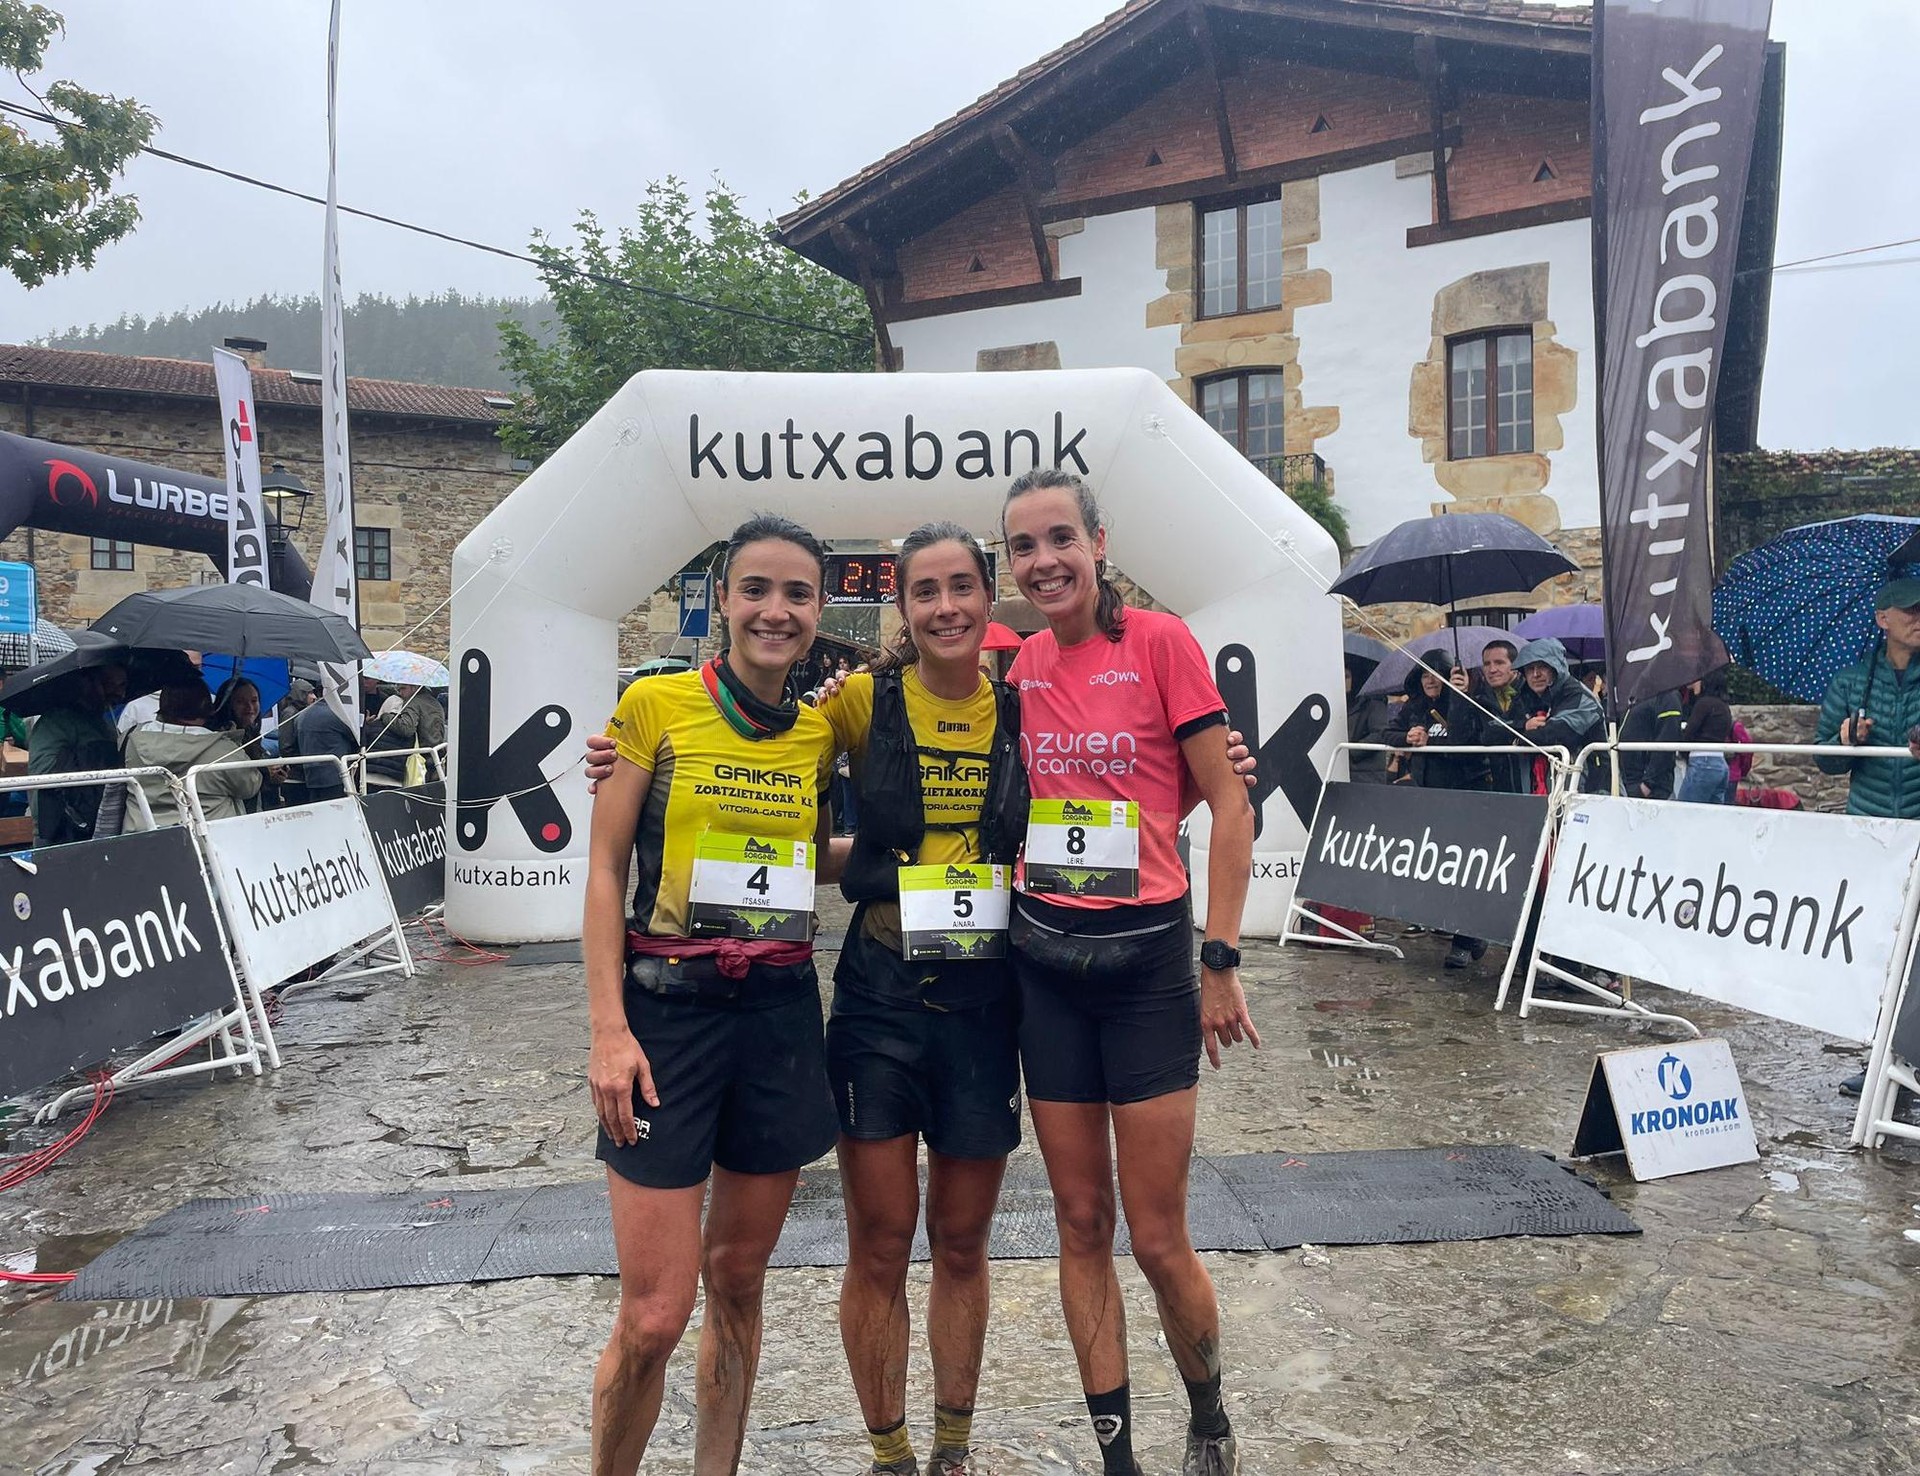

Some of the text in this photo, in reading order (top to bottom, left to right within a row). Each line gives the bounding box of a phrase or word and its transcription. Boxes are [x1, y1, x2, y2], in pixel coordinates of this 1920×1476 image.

[689, 411, 1089, 482] kutxabank
[1088, 670, 1141, 686] CROWN
[1036, 731, 1136, 754] zuren
[714, 763, 802, 789] GAIKAR
[1036, 758, 1137, 779] camper
[694, 784, 795, 804] ZORTZIETAKOAK
[718, 803, 801, 819] VITORIA-GASTEIZ
[1066, 826, 1086, 855] 8
[1066, 857, 1085, 865] LEIRE
[1319, 814, 1516, 895] kutxabank
[236, 839, 371, 931] kutxabank
[454, 861, 571, 887] kutxabank
[746, 866, 770, 895] 4
[741, 897, 771, 906] ITSASNE
[953, 890, 974, 918] 5
[1567, 842, 1865, 965] kutxabank
[0, 885, 202, 1019] xabank
[1631, 1097, 1739, 1136] KRONOAK
[1684, 1122, 1741, 1138] kronoak.com
